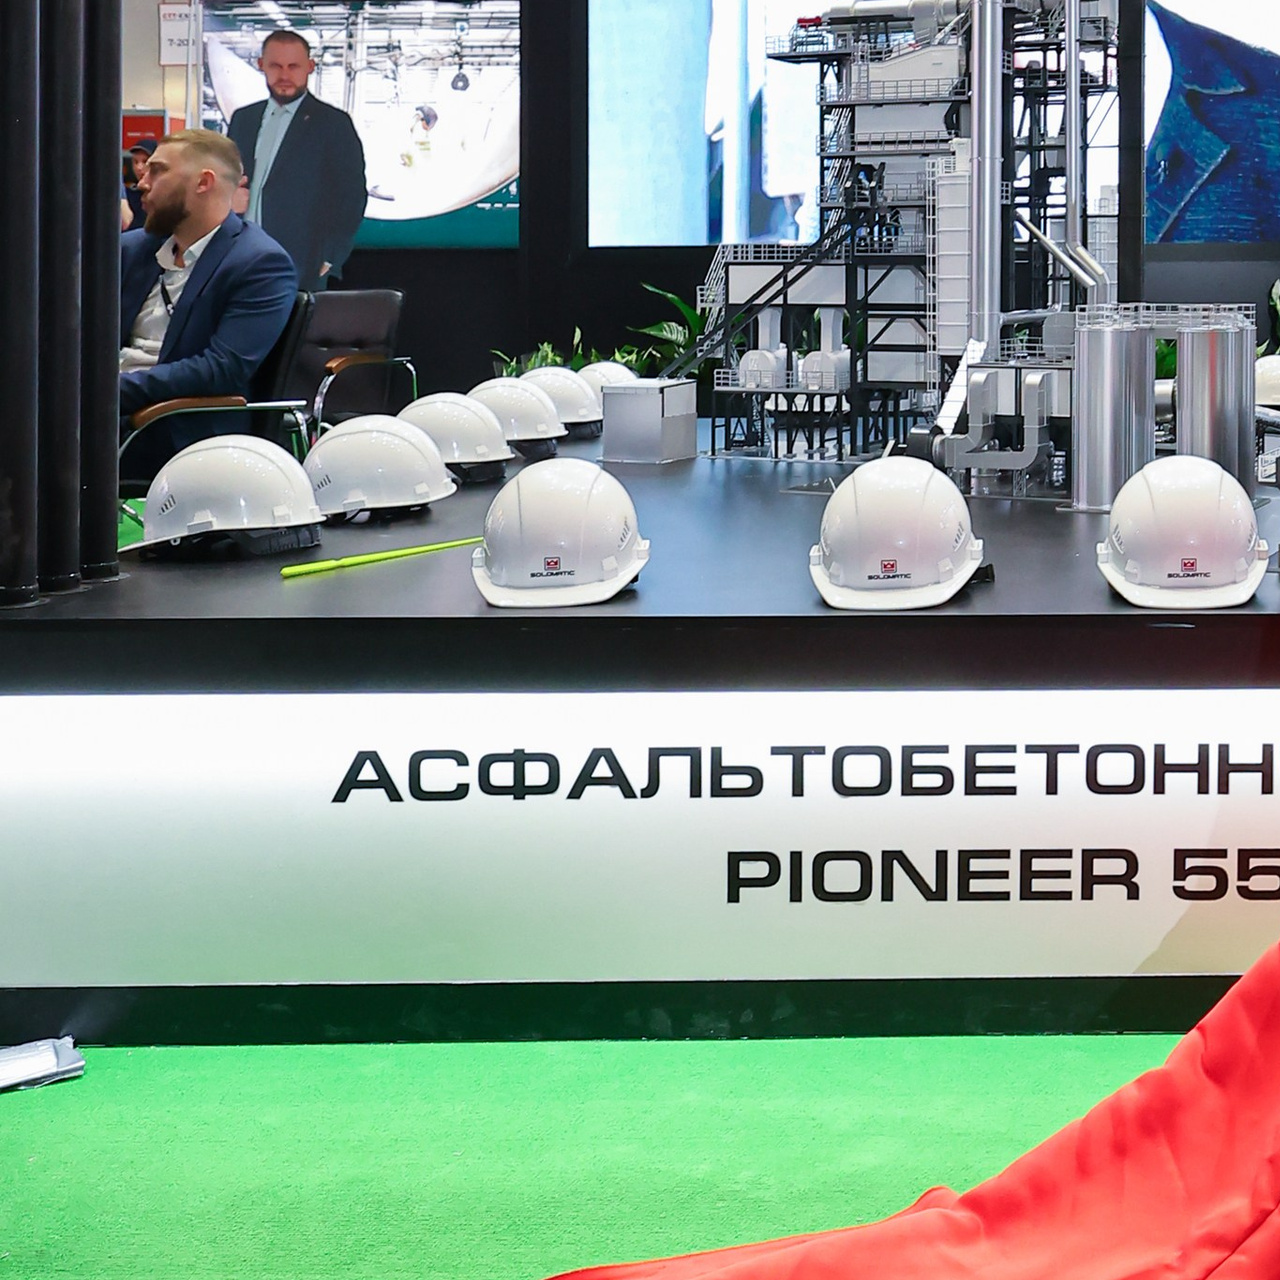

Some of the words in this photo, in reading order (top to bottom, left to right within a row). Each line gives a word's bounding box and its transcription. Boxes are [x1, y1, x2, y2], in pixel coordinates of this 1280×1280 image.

[530, 570, 575, 578] SOLOMATIC
[867, 573, 912, 581] SOLOMATIC
[727, 848, 1140, 904] PIONEER
